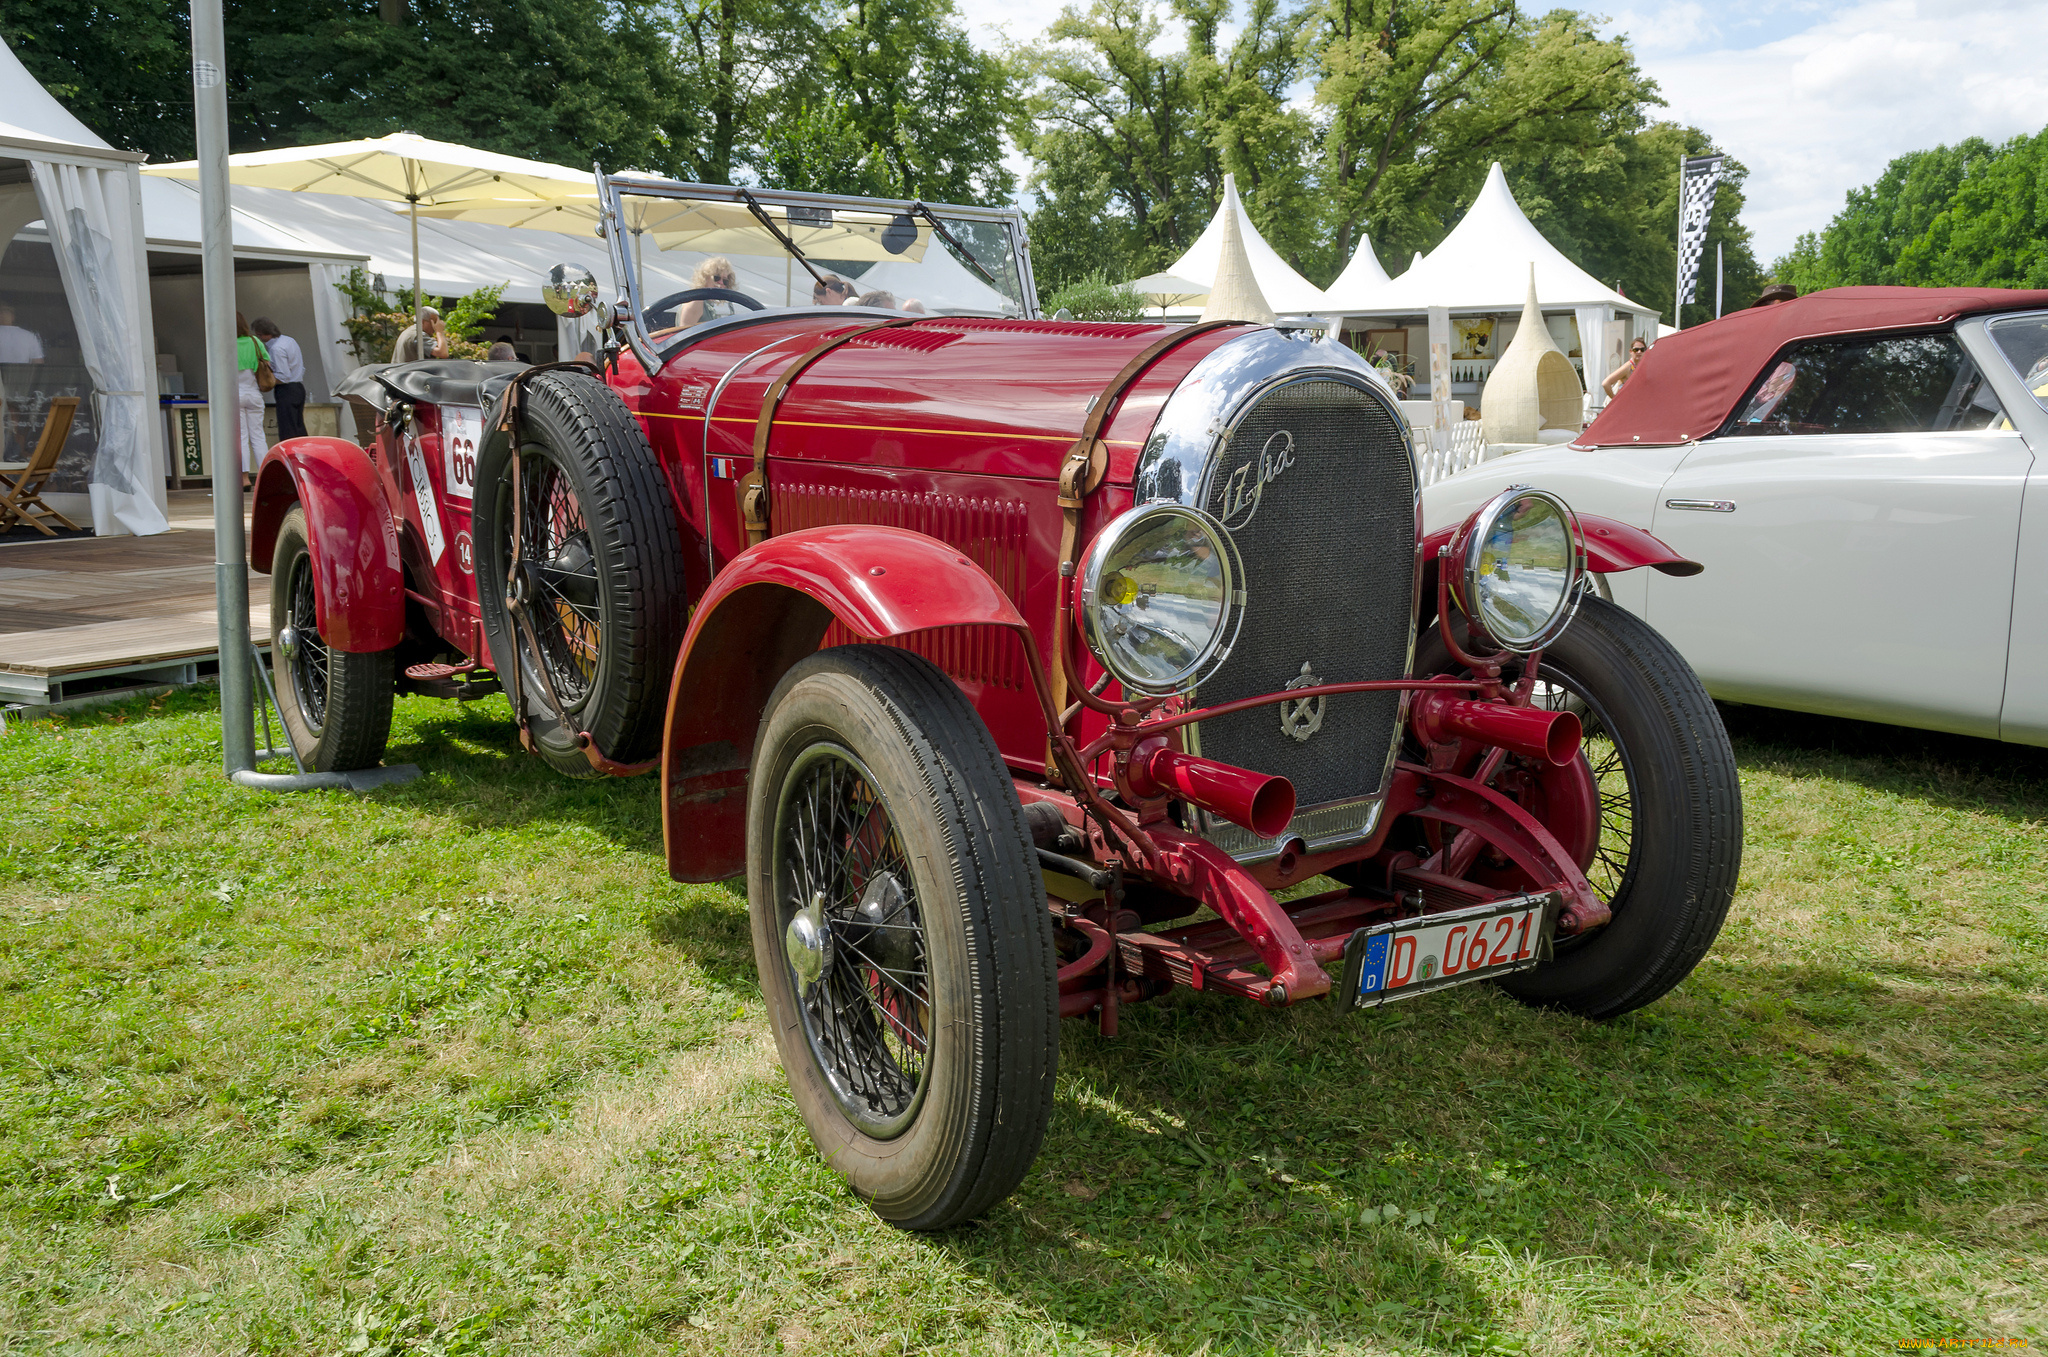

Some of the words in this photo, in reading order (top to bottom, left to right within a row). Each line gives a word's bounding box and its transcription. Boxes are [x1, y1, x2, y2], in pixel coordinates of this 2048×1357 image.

[184, 411, 198, 459] Bolten
[452, 437, 475, 487] 66
[459, 542, 472, 565] 14
[1387, 935, 1417, 989] D
[1442, 912, 1534, 976] 0621
[1366, 974, 1376, 990] D
